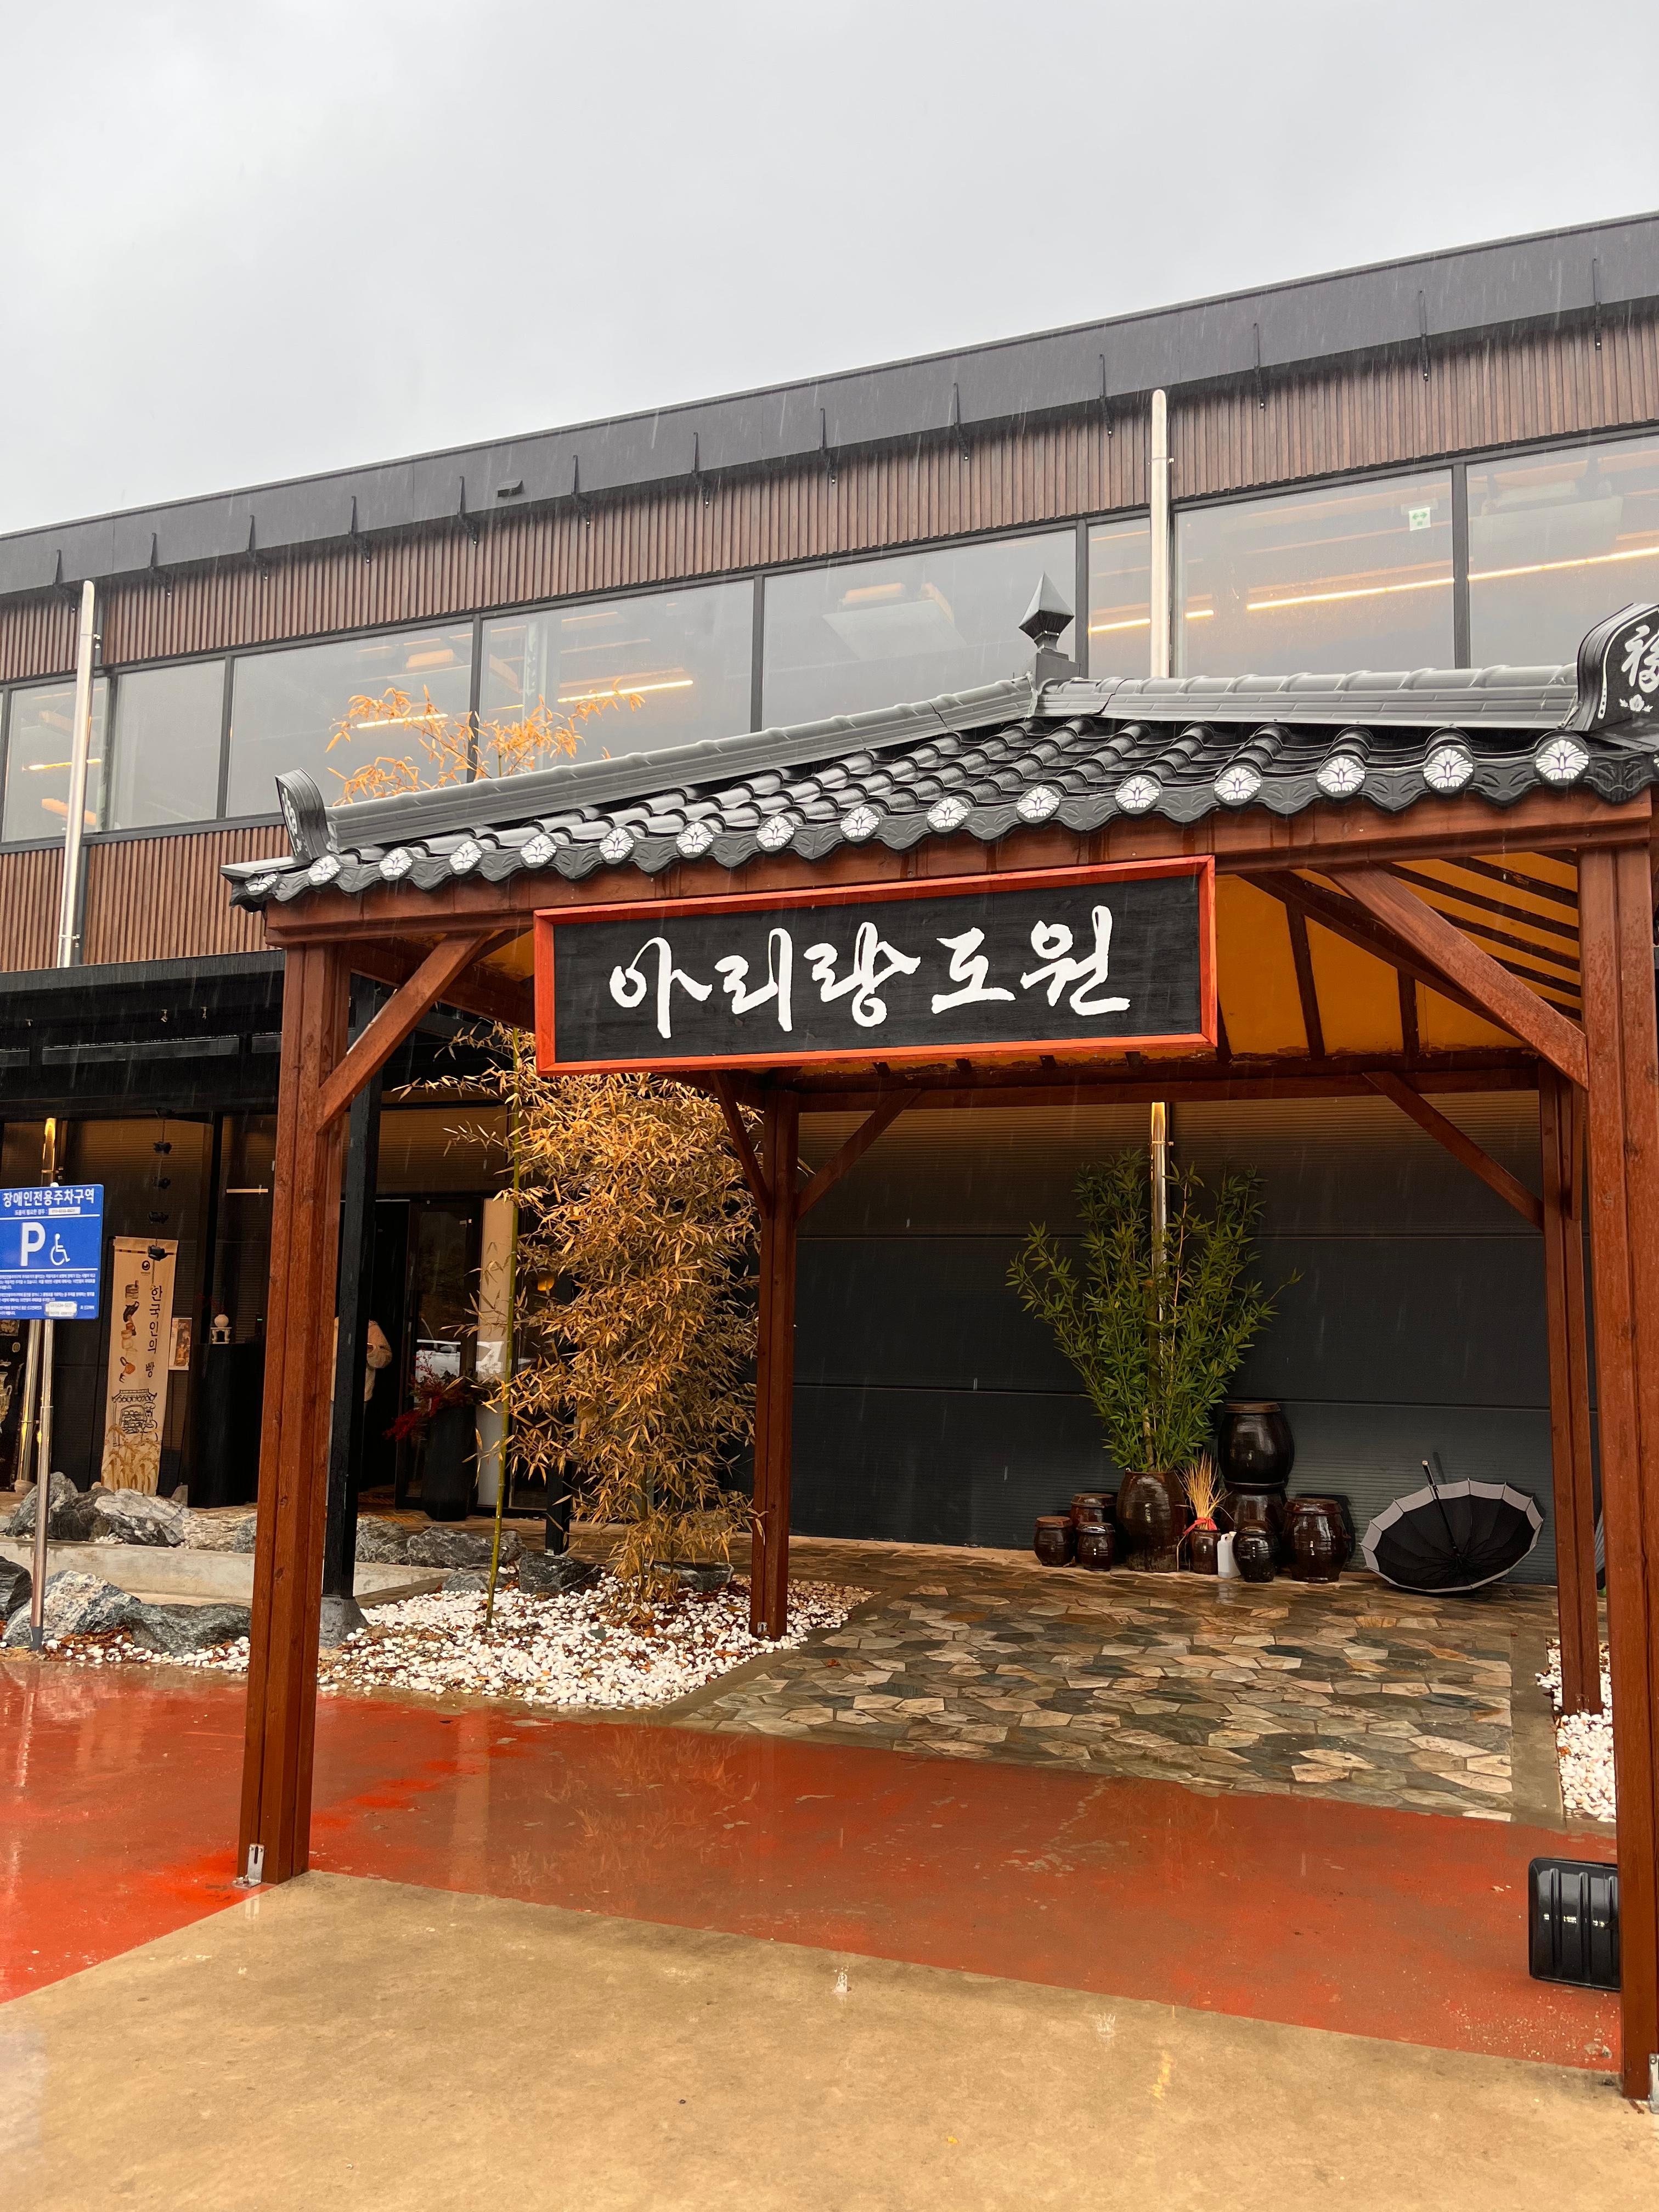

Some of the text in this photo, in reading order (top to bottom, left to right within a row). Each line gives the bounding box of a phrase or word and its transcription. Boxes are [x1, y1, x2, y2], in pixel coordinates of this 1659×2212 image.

[3, 1188, 95, 1207] 장애인전용주차구역
[20, 1222, 46, 1267] P
[145, 1285, 163, 1378] 한국인의 빵
